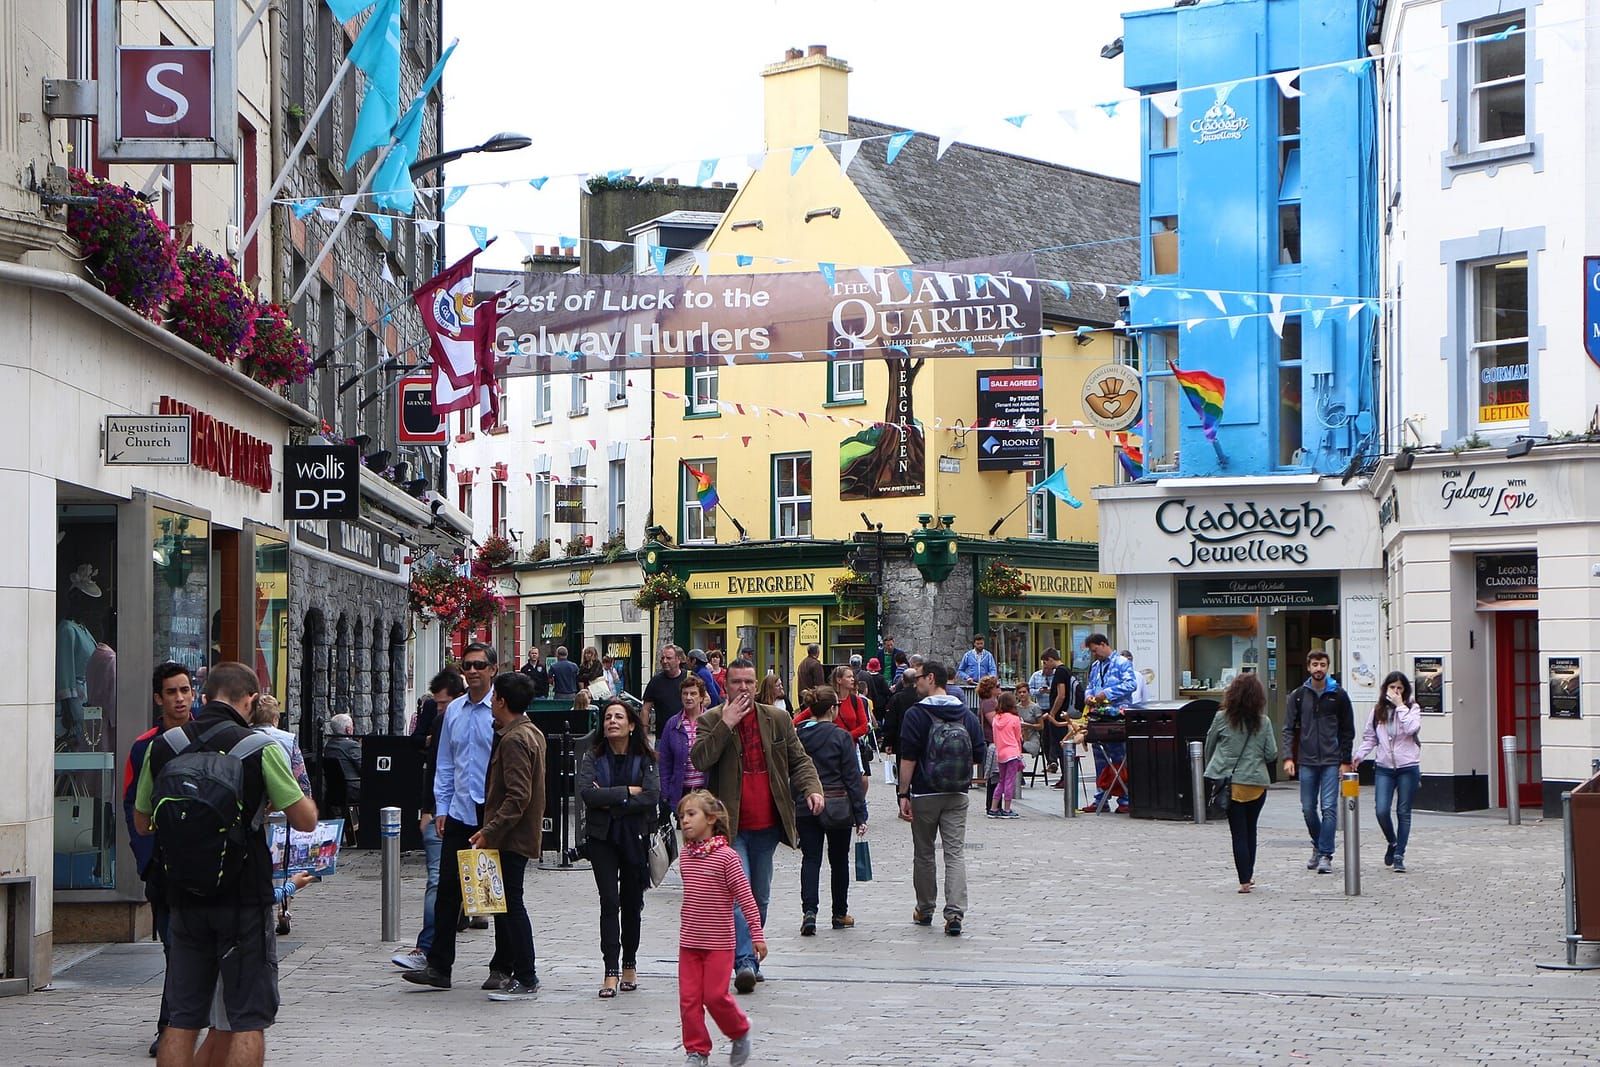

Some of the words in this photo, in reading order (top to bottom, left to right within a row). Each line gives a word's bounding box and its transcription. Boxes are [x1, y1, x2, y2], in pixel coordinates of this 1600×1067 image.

[143, 62, 190, 125] S
[1190, 117, 1249, 134] Claddagh
[832, 281, 871, 297] THE
[873, 270, 1013, 306] LATIN
[495, 288, 556, 313] Best
[564, 289, 595, 312] of
[602, 289, 675, 312] Luck
[683, 290, 714, 309] to
[722, 287, 770, 308] the
[832, 298, 1027, 348] QUARTER
[495, 325, 622, 361] Galway
[633, 321, 771, 354] Hurlers
[882, 338, 917, 348] WHERE
[960, 334, 993, 344] COMES
[1009, 379, 1038, 387] AGREED
[1488, 389, 1522, 404] SALES
[109, 422, 186, 435] Augustinian
[125, 436, 171, 448] Church
[1002, 439, 1040, 447] ROONEY
[296, 454, 345, 480] wallis
[1442, 470, 1462, 479] FROM
[1441, 470, 1495, 510] Galway
[1507, 479, 1527, 487] WITH
[295, 489, 346, 510] DP
[556, 499, 583, 508] SUBWAY
[1155, 499, 1336, 543] Claddagh
[1168, 539, 1309, 568] Jewellers
[568, 569, 594, 586] SUBWAY
[1498, 565, 1529, 575] LEGEND
[693, 581, 720, 590] HEALTH
[727, 572, 816, 595] EVERGREEN
[1024, 572, 1093, 594] EVERGREEN
[1098, 581, 1116, 590] STORE
[1486, 576, 1527, 587] CLADDAGH
[541, 622, 567, 639] SUBWAY
[606, 641, 632, 658] SUBWAY
